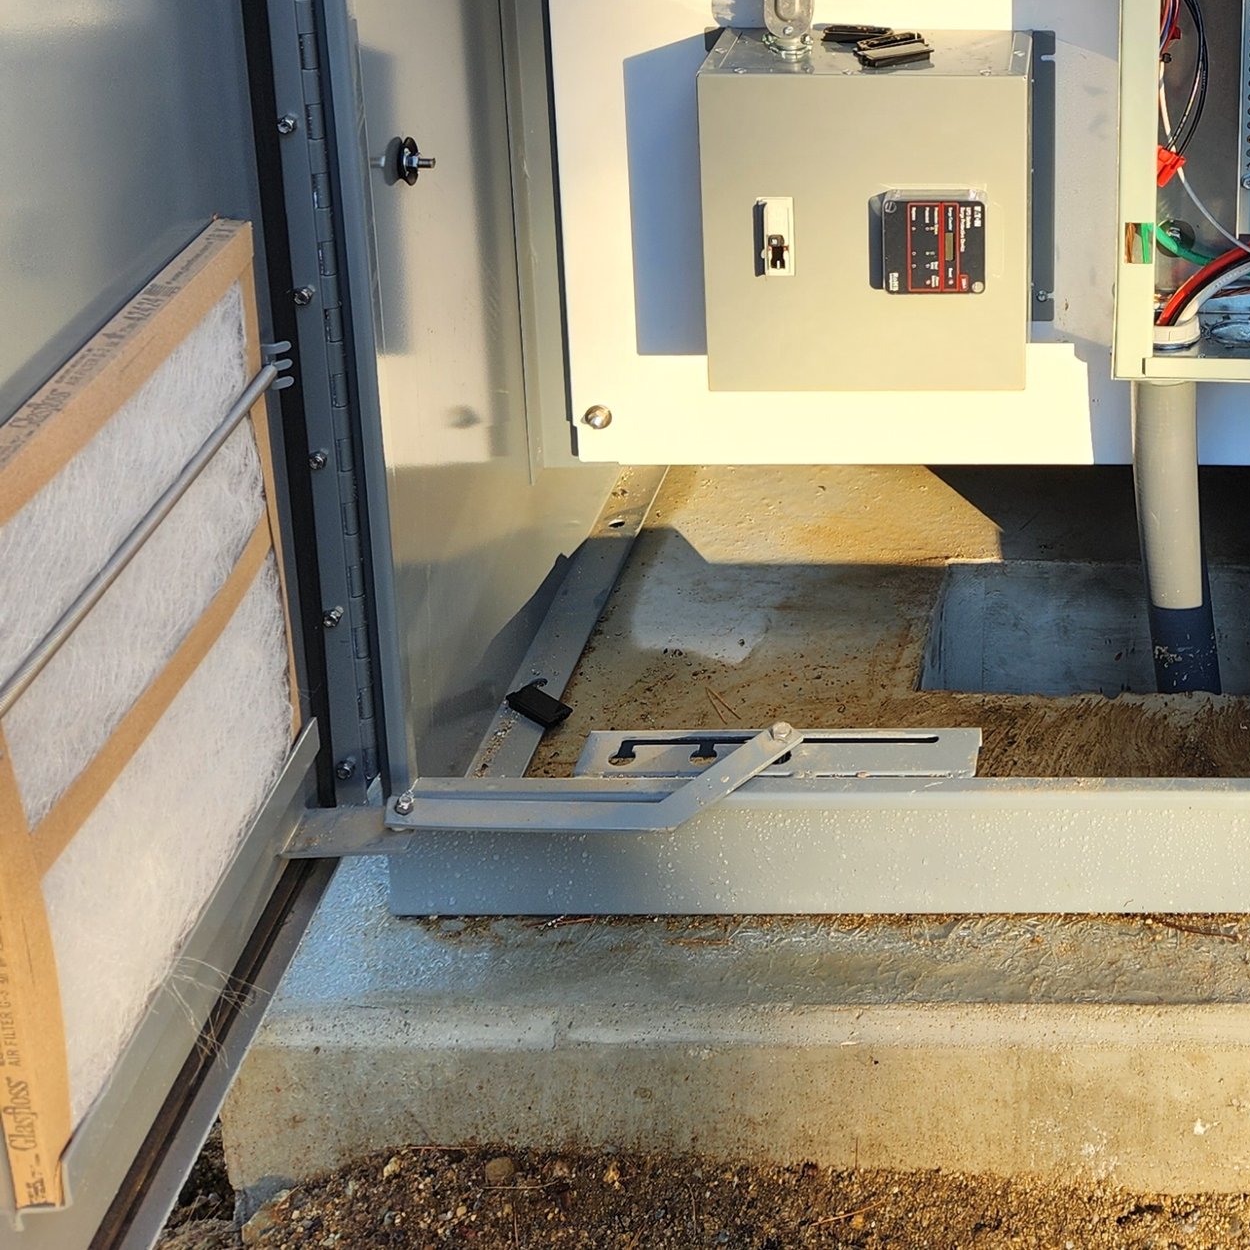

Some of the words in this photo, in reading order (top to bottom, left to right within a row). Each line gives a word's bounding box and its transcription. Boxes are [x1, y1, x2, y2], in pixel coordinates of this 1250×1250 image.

[3, 1011, 17, 1048] FILTER
[7, 1050, 20, 1067] AIR
[3, 1076, 38, 1151] Glasfloss
